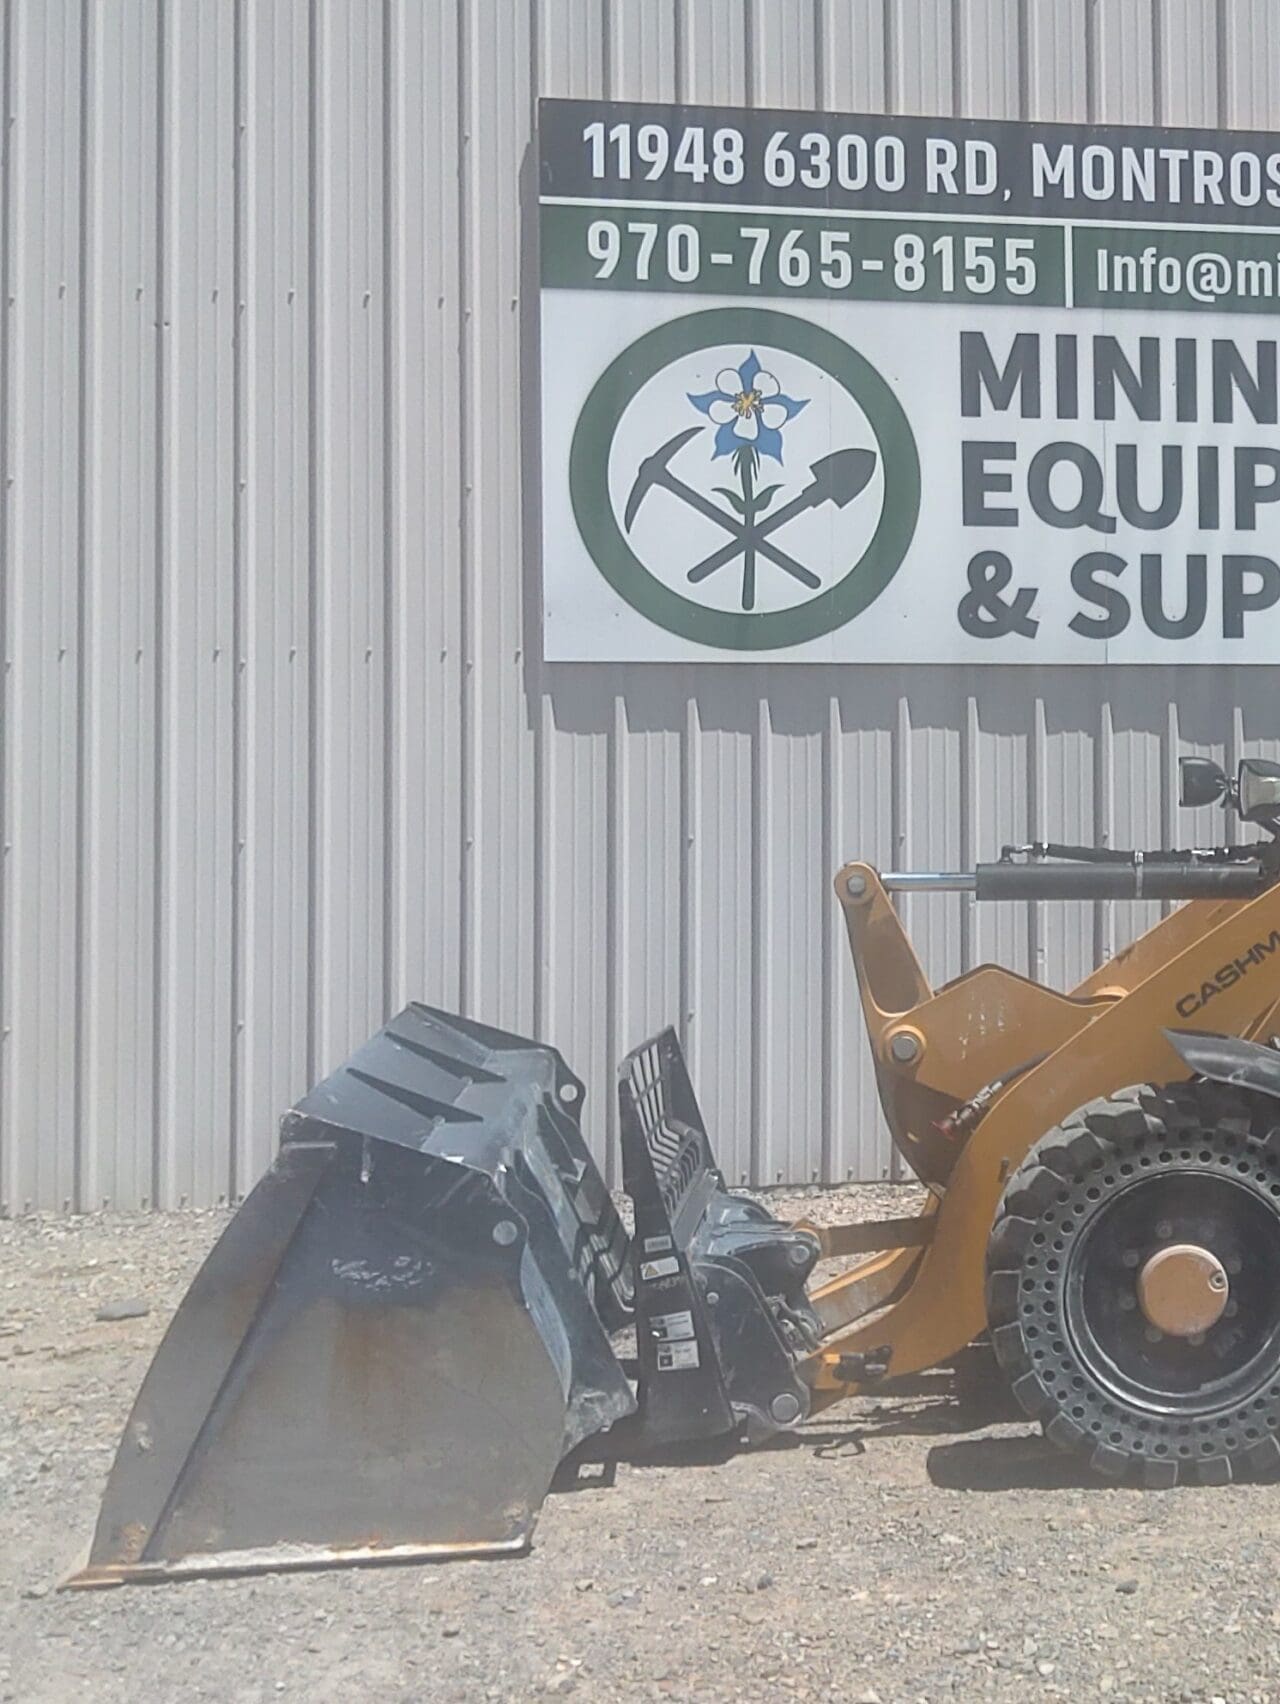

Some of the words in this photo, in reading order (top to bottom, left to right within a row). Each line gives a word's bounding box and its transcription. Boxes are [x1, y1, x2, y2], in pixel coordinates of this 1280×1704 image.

[583, 122, 745, 185] 11948
[764, 131, 906, 192] 6300
[926, 138, 1012, 202] RD,
[586, 220, 1037, 296] 970-765-8155
[957, 550, 1039, 640] &
